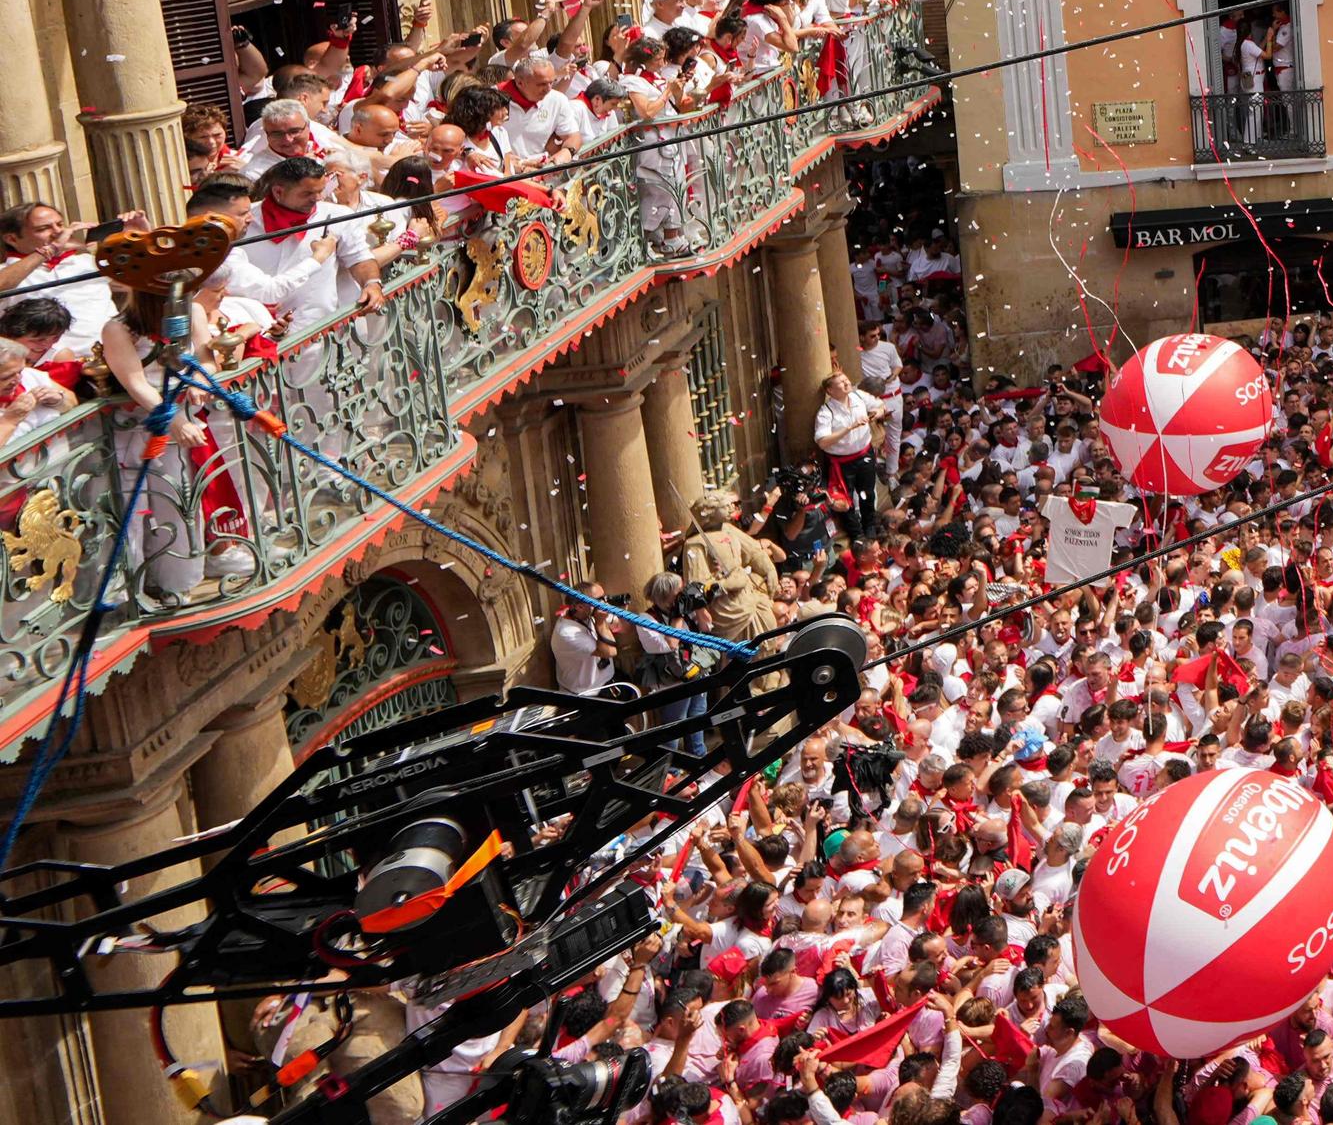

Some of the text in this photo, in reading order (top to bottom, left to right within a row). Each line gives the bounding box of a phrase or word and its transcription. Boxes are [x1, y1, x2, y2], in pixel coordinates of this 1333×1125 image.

[1136, 224, 1241, 248] BAR MOL
[1064, 536, 1098, 547] PALESTINA
[338, 756, 450, 799] AEROMEDIA
[1222, 782, 1262, 825] Quesos
[1197, 777, 1315, 902] Albéniz
